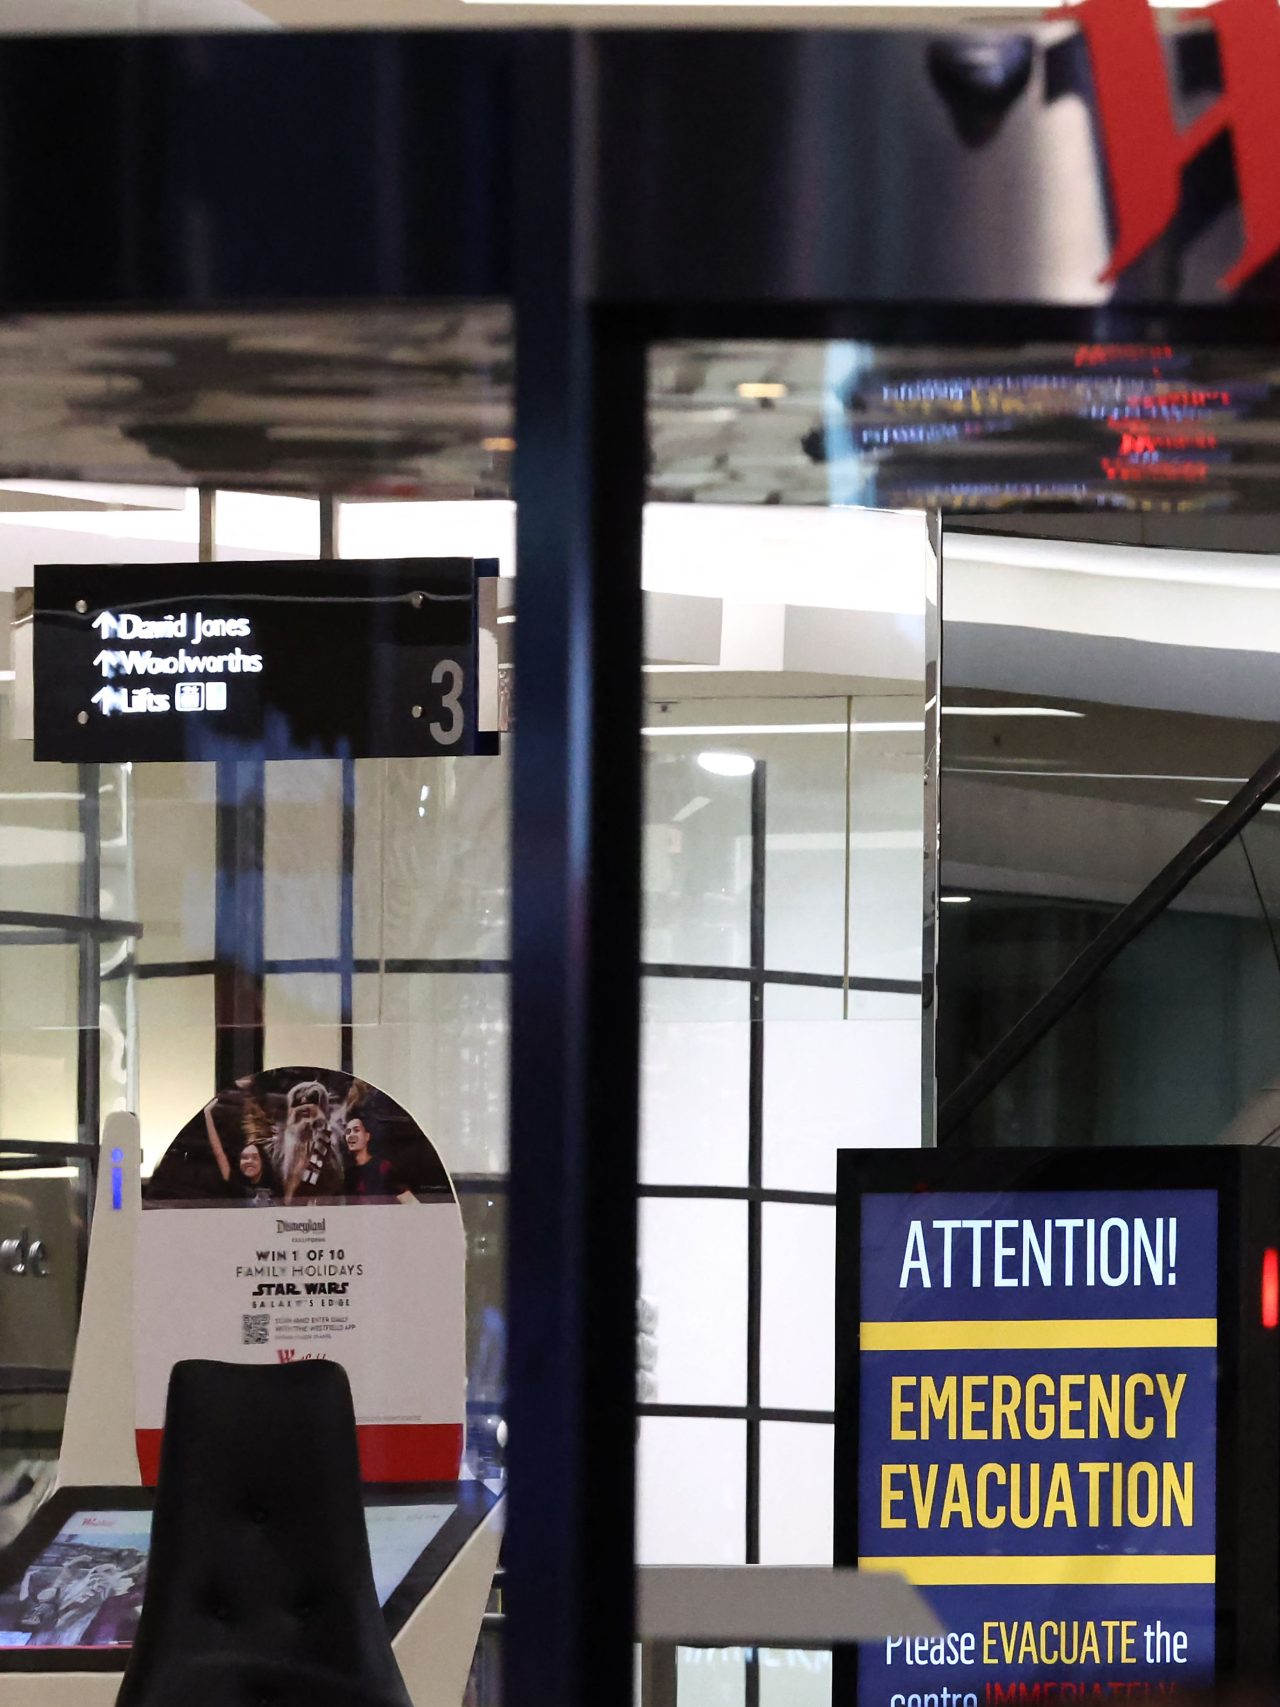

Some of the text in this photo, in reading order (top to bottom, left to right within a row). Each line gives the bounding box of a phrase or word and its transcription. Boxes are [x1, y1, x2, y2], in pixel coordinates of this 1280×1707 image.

[116, 611, 250, 644] David Jones
[120, 647, 263, 675] Woolworths
[121, 687, 171, 713] Lifts
[429, 659, 464, 746] 3
[256, 1249, 345, 1262] WIN 1 OF 10
[899, 1217, 1177, 1289] ATTENTION!
[236, 1264, 364, 1277] FAMILY HOLIDAYS
[252, 1282, 349, 1296] STAR WARS
[321, 1298, 350, 1307] EDGE
[890, 1373, 1187, 1442] EMERGENCY
[880, 1461, 1194, 1530] EVACUATION
[886, 1620, 1188, 1665] Please EVACUATE the
